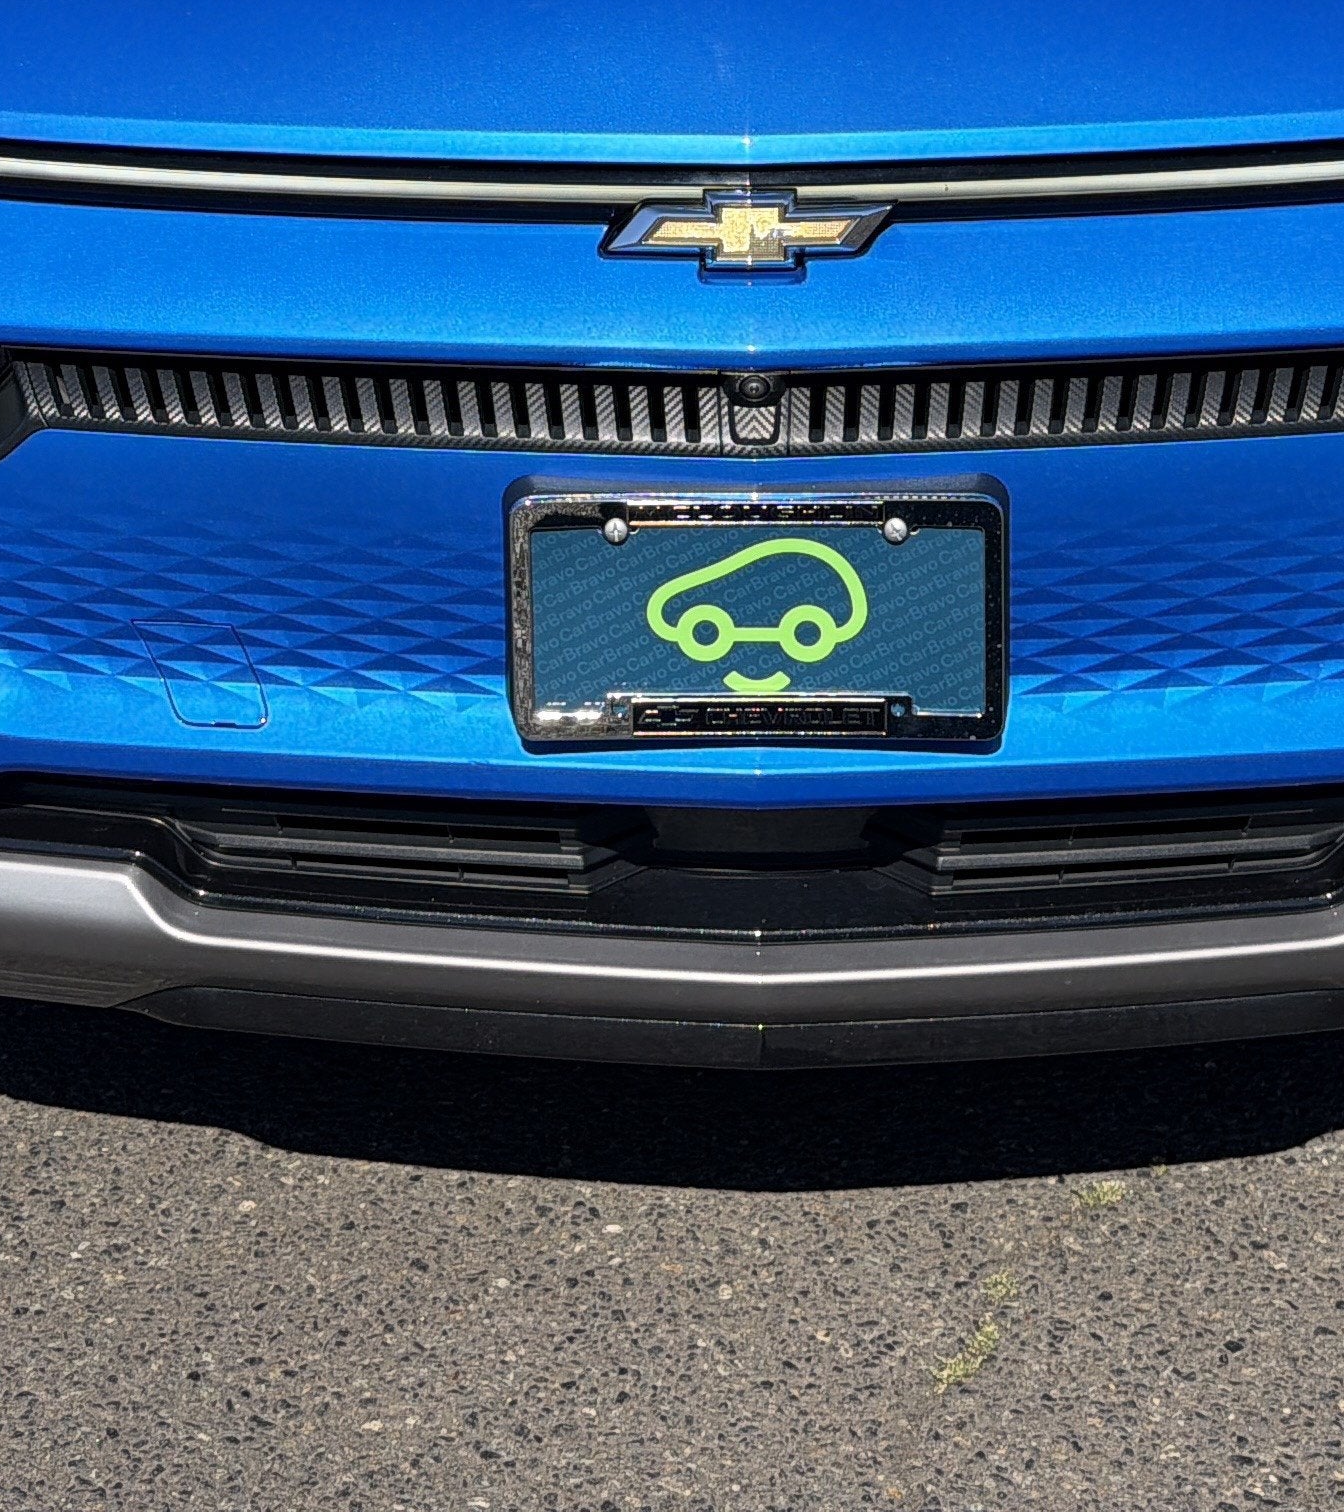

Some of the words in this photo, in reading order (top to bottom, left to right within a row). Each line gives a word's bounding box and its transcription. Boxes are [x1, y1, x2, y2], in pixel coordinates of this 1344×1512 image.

[592, 564, 666, 605] CarBravo
[665, 529, 739, 569] CarBravo
[888, 526, 962, 567] CarBravo
[542, 567, 616, 607] CarBravo
[615, 531, 689, 572] CarBravo
[864, 558, 938, 599] CarBravo
[905, 559, 979, 600] CarBravo
[559, 600, 633, 641] CarBravo
[576, 634, 650, 674] CarBravo
[723, 563, 797, 604] CarBravo
[882, 592, 956, 633] CarBravo
[535, 633, 609, 673] CarBravo
[849, 628, 923, 669] CarBravo
[899, 625, 973, 666] CarBravo
